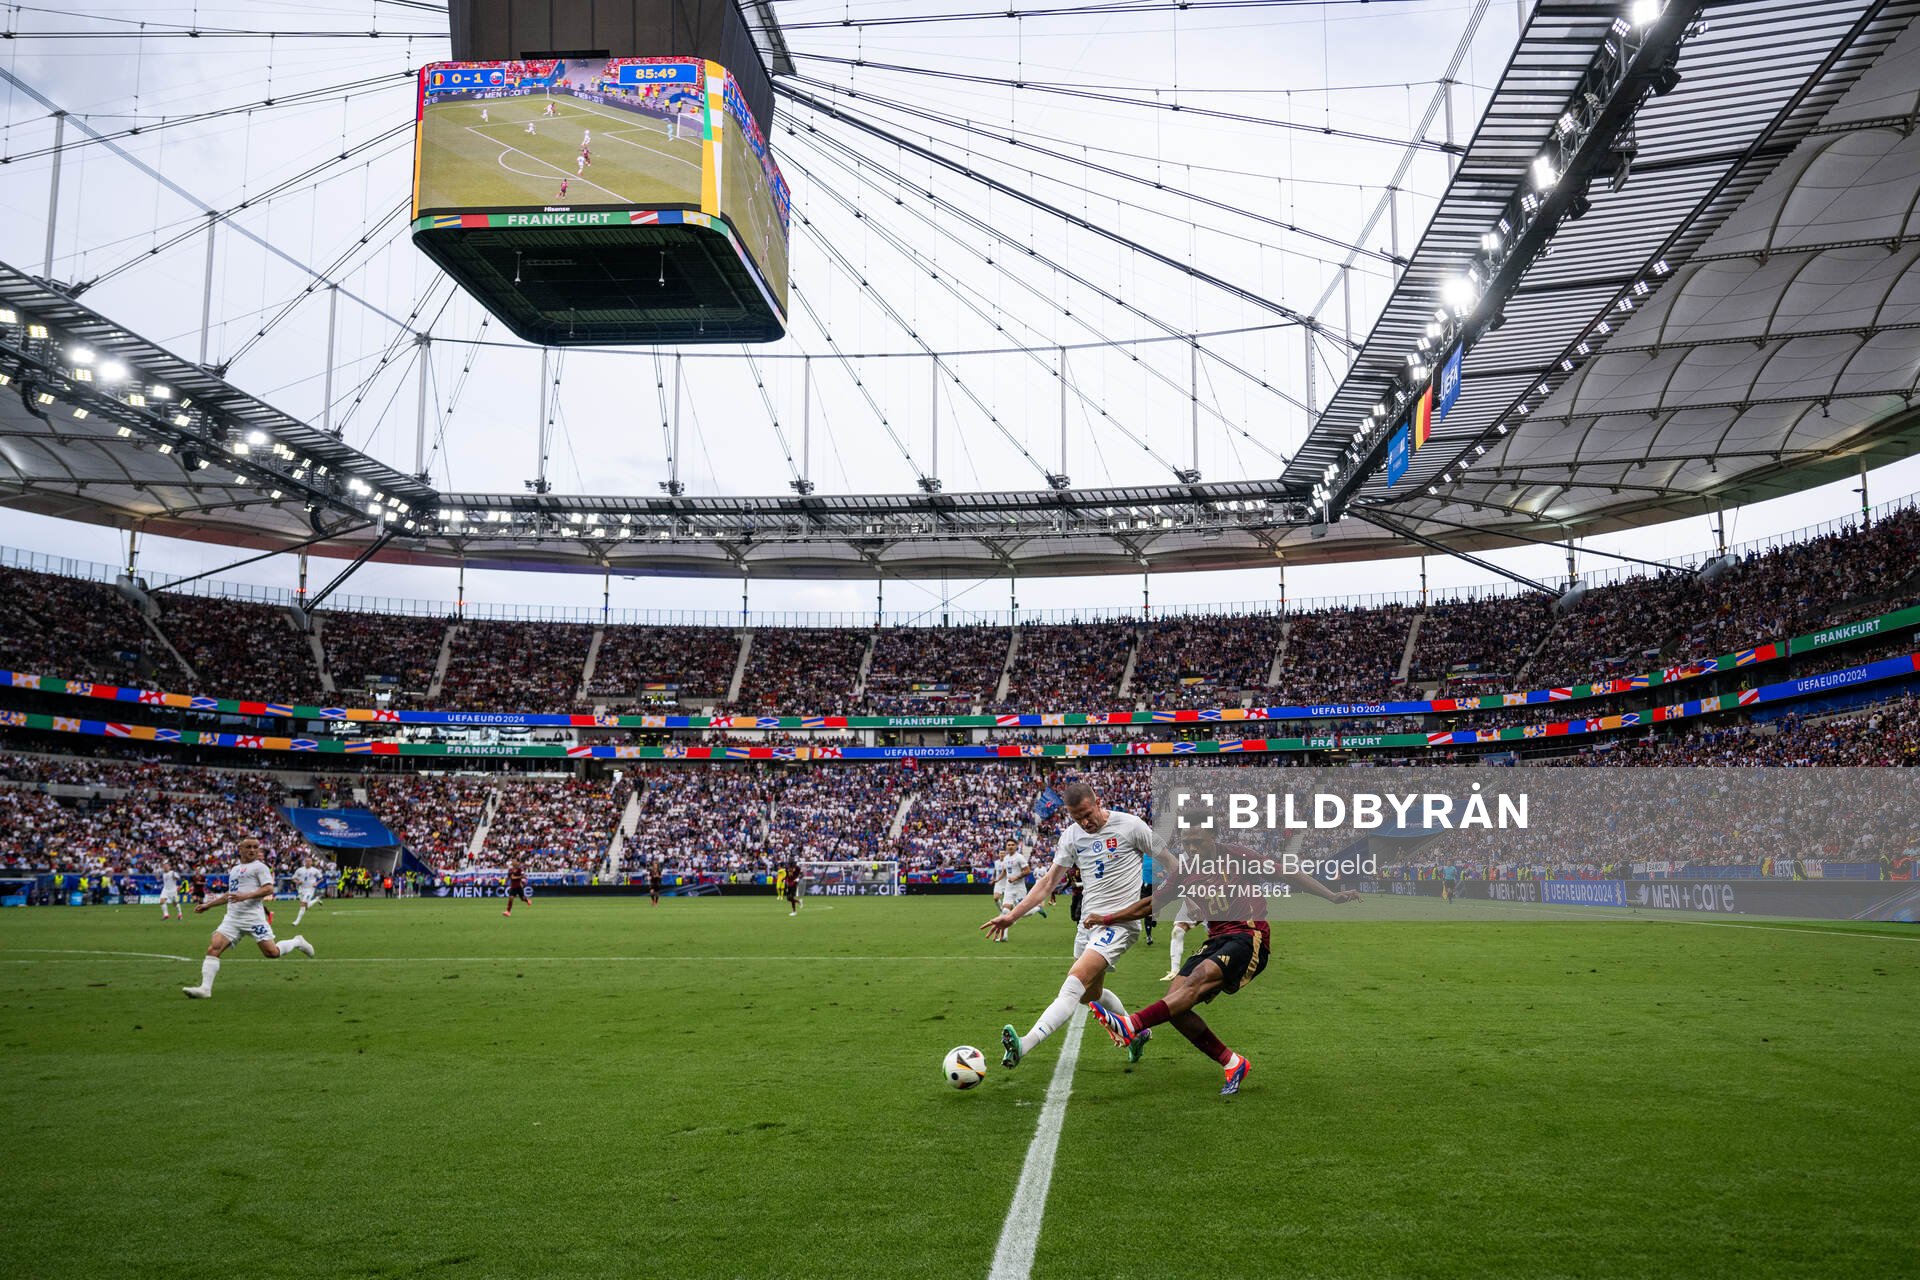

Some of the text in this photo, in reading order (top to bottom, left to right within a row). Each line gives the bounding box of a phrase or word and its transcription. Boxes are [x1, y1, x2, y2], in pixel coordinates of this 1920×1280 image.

[451, 73, 462, 84] 0
[473, 73, 484, 83] 1
[635, 68, 678, 80] 85:49
[507, 213, 612, 226] FRANKFURT
[1814, 619, 1880, 646] FRANKFURT
[888, 717, 956, 726] FRANKFURT
[1310, 737, 1382, 748] FRAKFURT
[446, 745, 522, 756] FRANKFURT
[1094, 859, 1105, 879] 3
[453, 886, 482, 898] MEN
[826, 884, 856, 896] MEN
[1207, 891, 1231, 916] 20
[1652, 883, 1681, 909] MEN
[1692, 883, 1735, 912] care
[1099, 927, 1116, 945] 3
